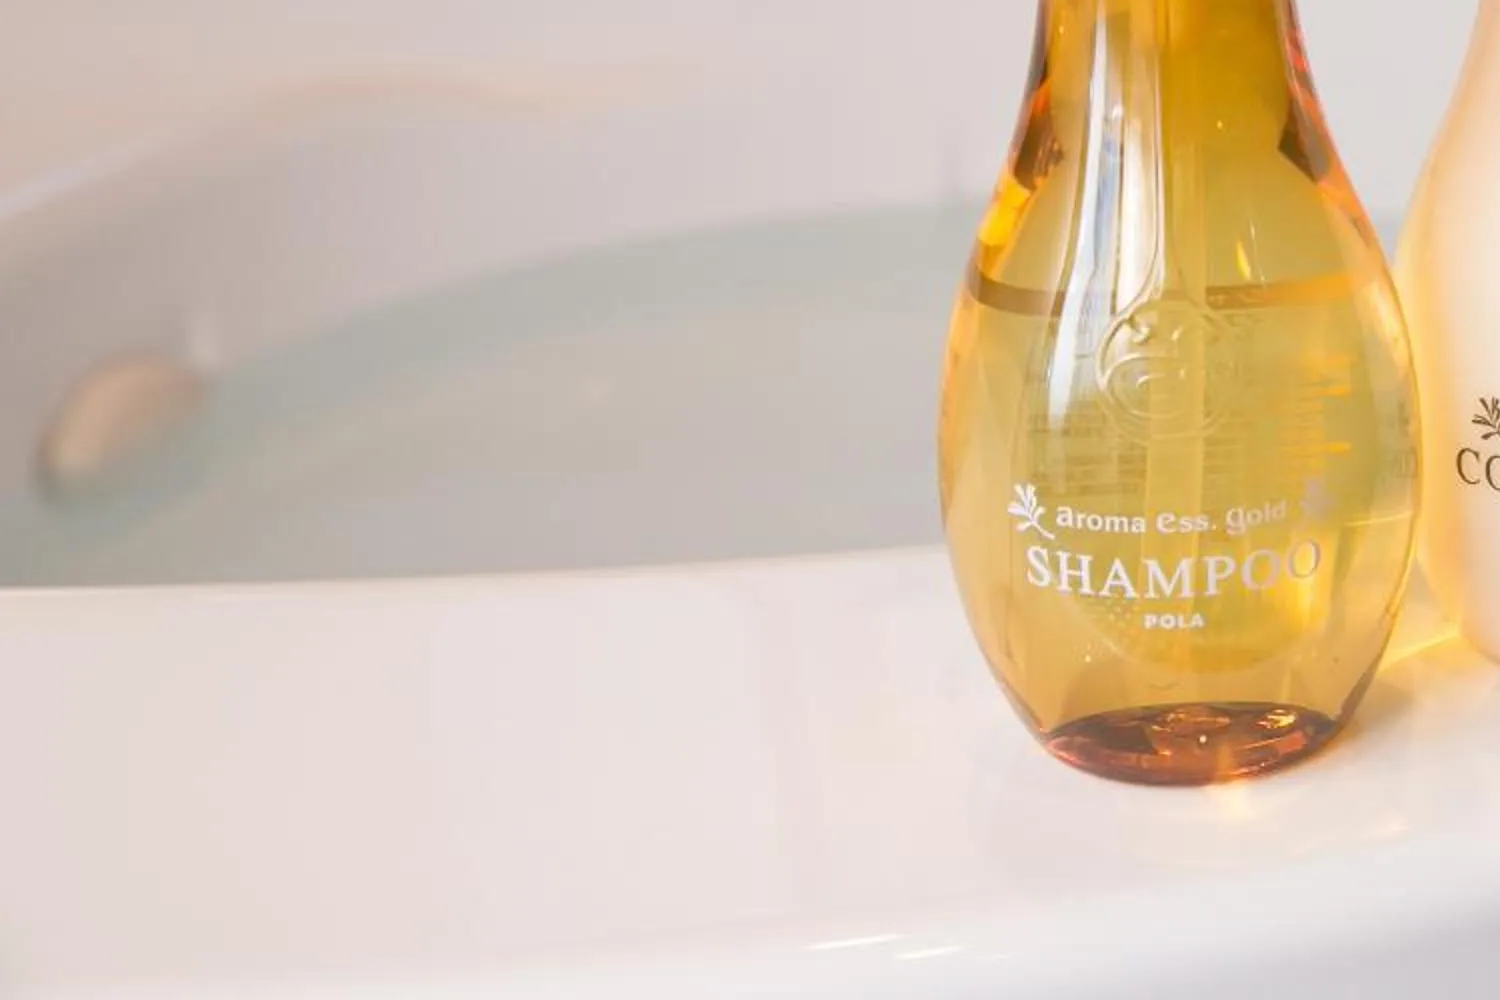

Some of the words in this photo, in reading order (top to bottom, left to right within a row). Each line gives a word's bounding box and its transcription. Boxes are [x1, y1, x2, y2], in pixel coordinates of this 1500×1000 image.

[1056, 506, 1147, 534] aroma
[1156, 511, 1218, 535] ess.
[1225, 498, 1288, 535] gold
[1026, 538, 1322, 600] SHAMPOO
[1143, 612, 1205, 630] POLA
